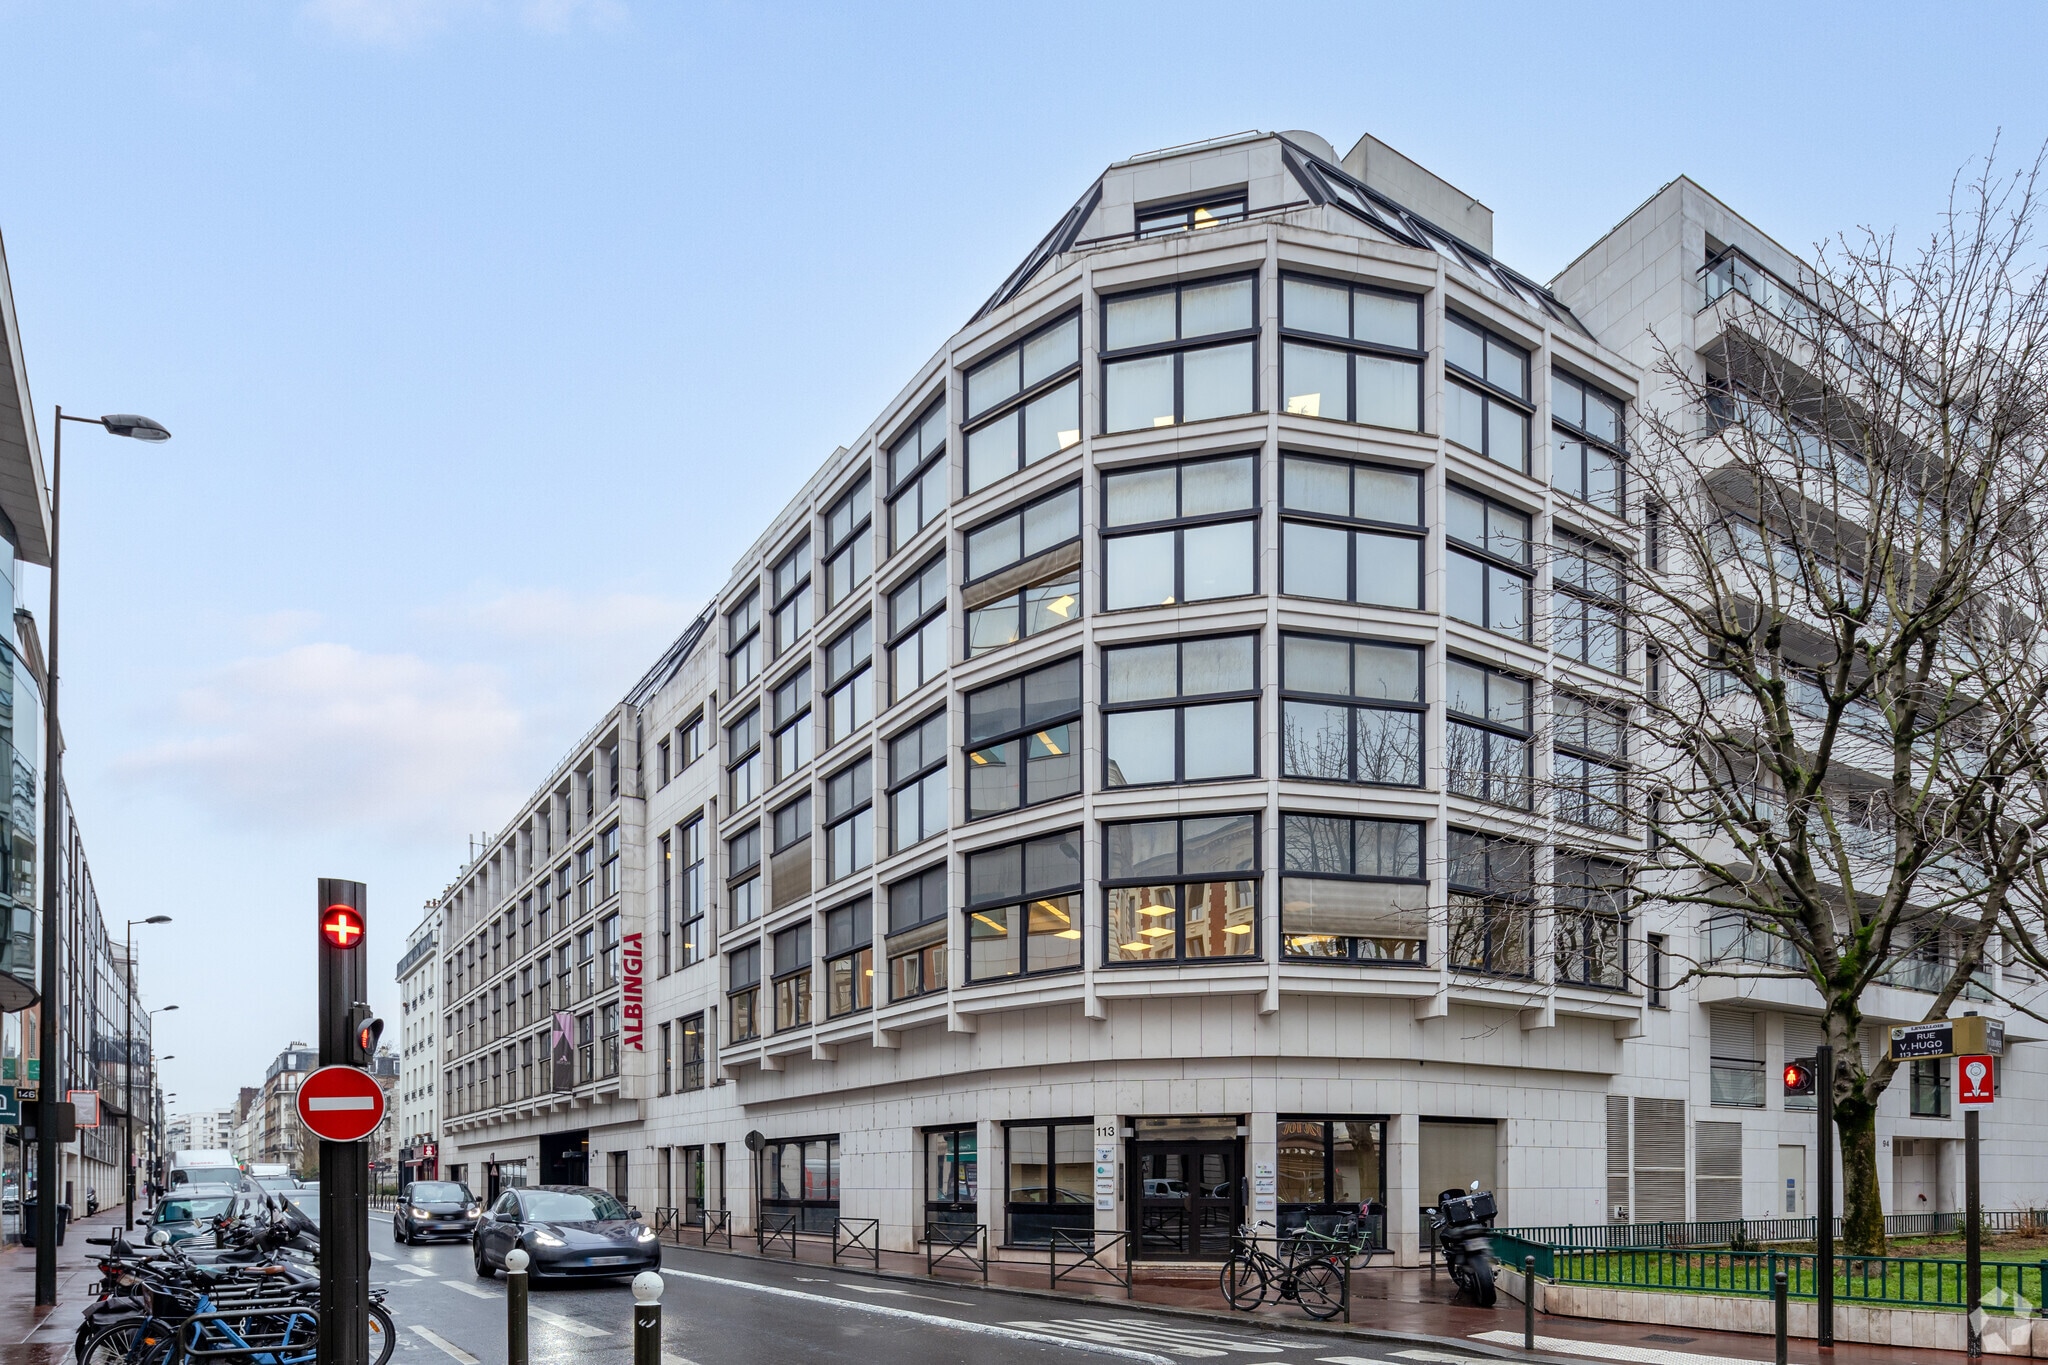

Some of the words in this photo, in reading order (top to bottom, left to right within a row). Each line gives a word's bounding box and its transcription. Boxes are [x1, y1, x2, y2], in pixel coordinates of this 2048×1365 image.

[623, 932, 643, 1051] ALBINGIA
[1917, 1032, 1936, 1040] RUE
[18, 1090, 36, 1098] 146
[1096, 1126, 1115, 1136] 113
